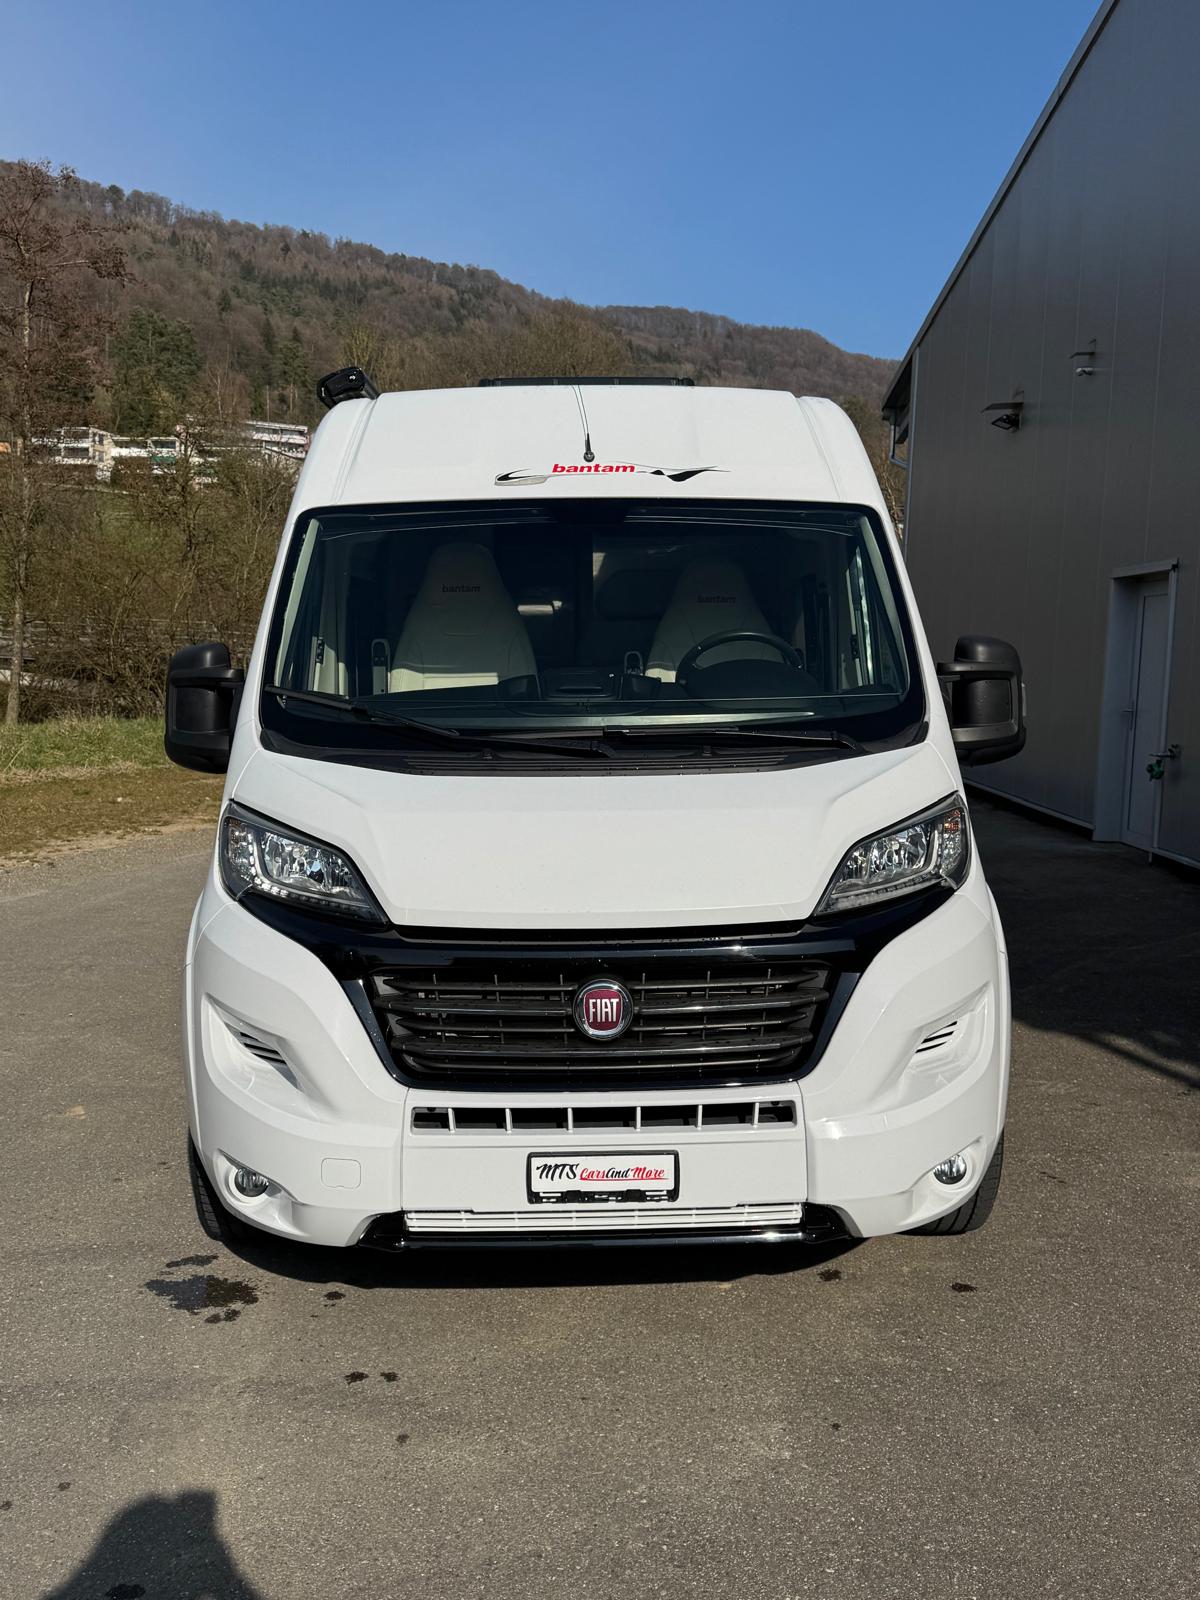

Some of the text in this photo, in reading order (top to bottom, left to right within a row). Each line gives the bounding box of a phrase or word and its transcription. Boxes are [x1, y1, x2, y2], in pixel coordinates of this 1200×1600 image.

[551, 463, 635, 474] bantam
[441, 583, 481, 593] bantam
[589, 998, 619, 1023] FIAT
[536, 1163, 580, 1181] MTS
